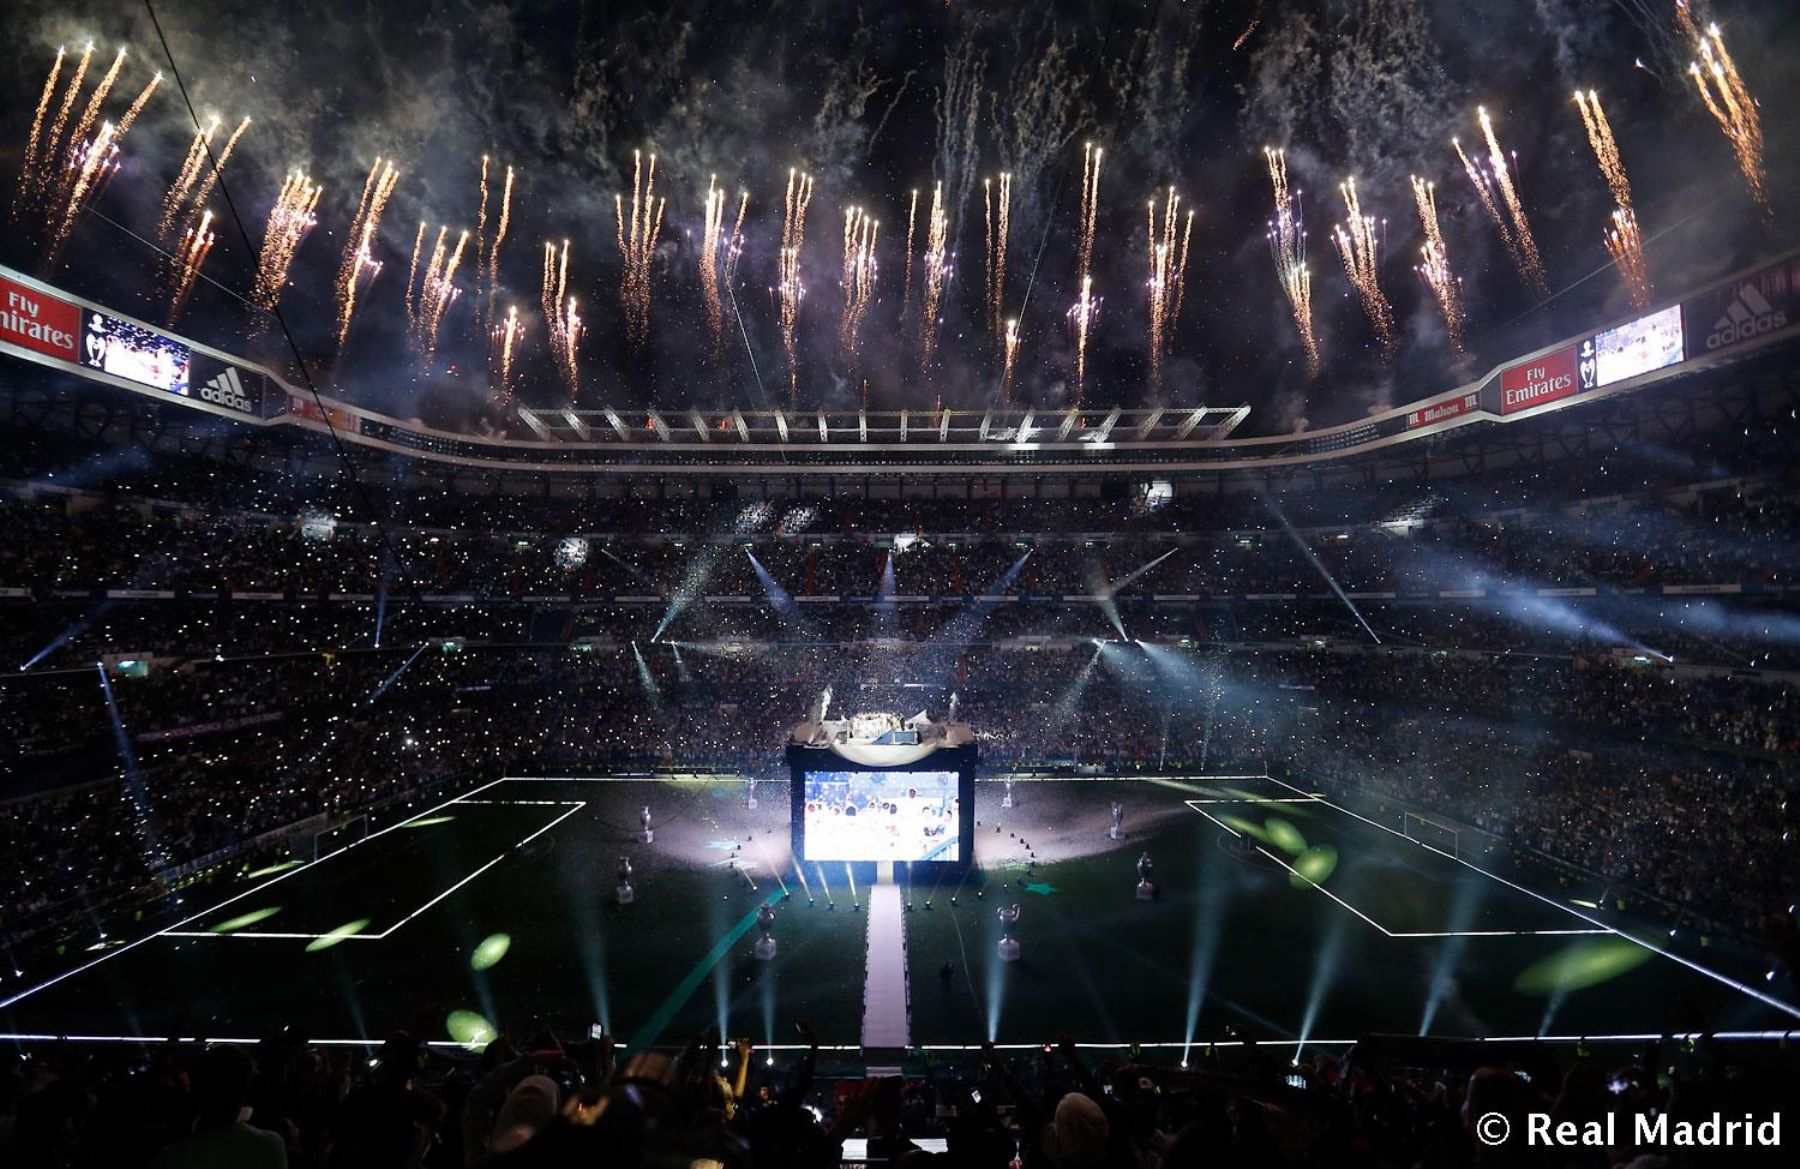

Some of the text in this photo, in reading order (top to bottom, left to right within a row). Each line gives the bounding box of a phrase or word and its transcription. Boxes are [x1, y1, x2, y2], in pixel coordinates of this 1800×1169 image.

[9, 291, 39, 318] Fly
[0, 310, 74, 349] irates
[1706, 311, 1787, 349] adidas
[1527, 367, 1545, 381] Fly
[200, 387, 252, 412] adidas
[1506, 374, 1572, 405] Emirates
